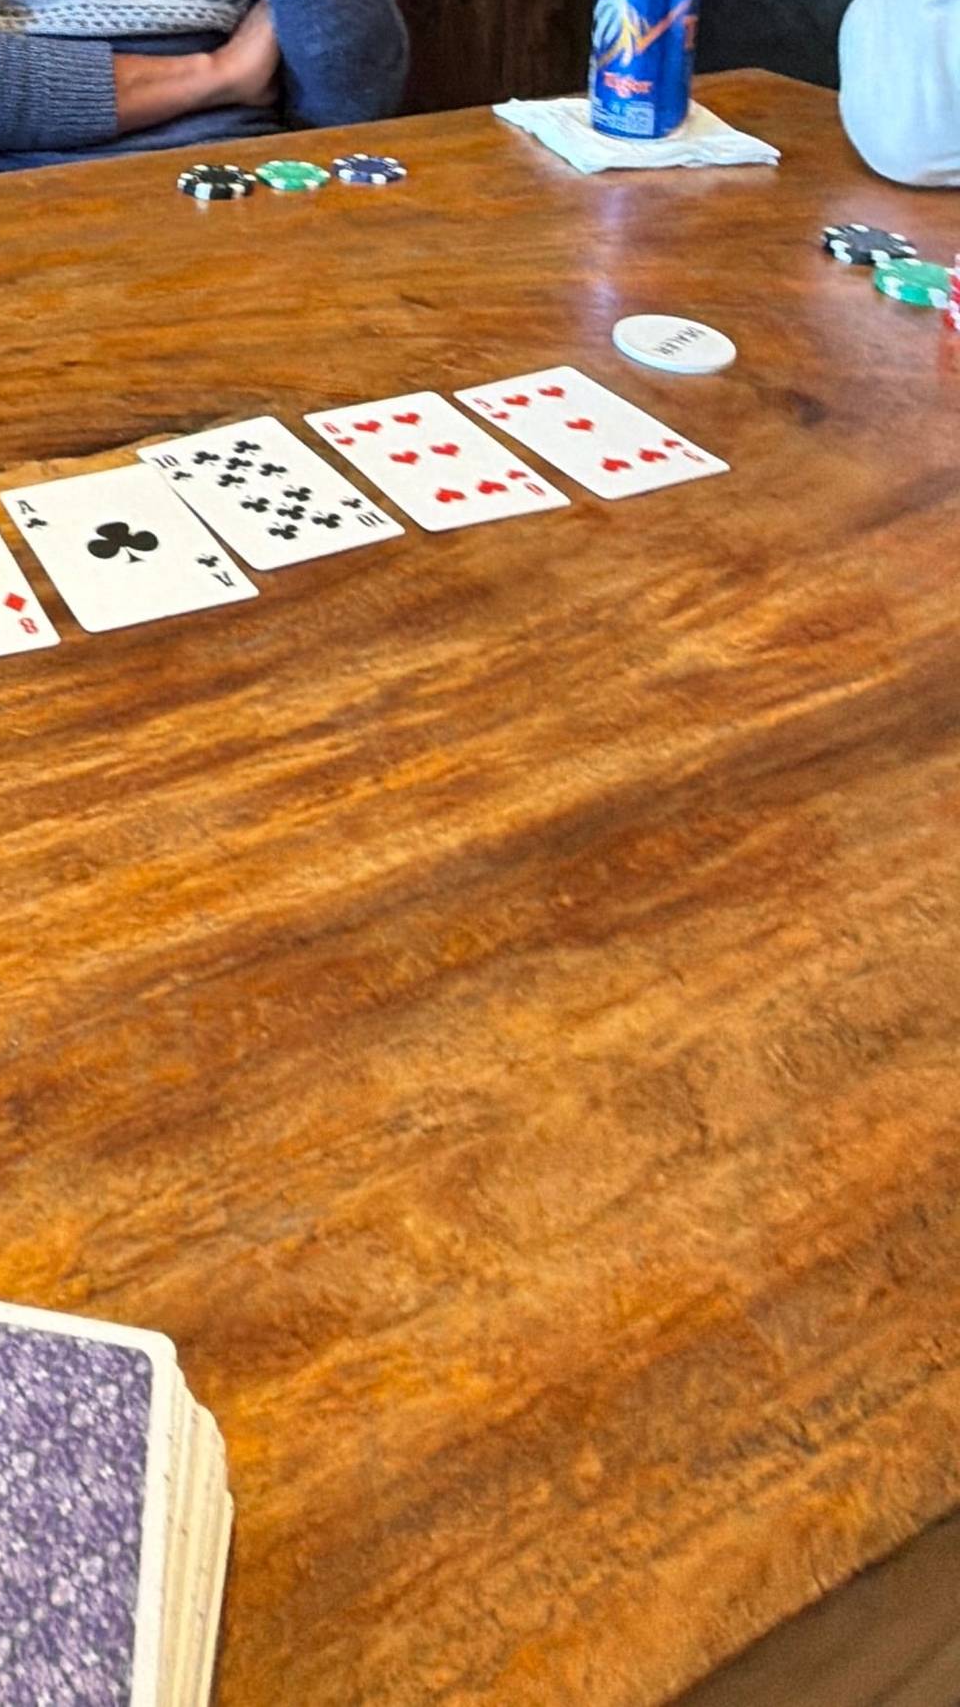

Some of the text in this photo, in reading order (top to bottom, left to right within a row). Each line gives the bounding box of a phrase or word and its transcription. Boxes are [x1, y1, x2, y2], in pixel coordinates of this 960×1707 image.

[150, 454, 181, 469] 10
[15, 499, 38, 515] A
[355, 511, 389, 528] 10
[211, 570, 237, 588] A
[19, 617, 39, 634] 8
